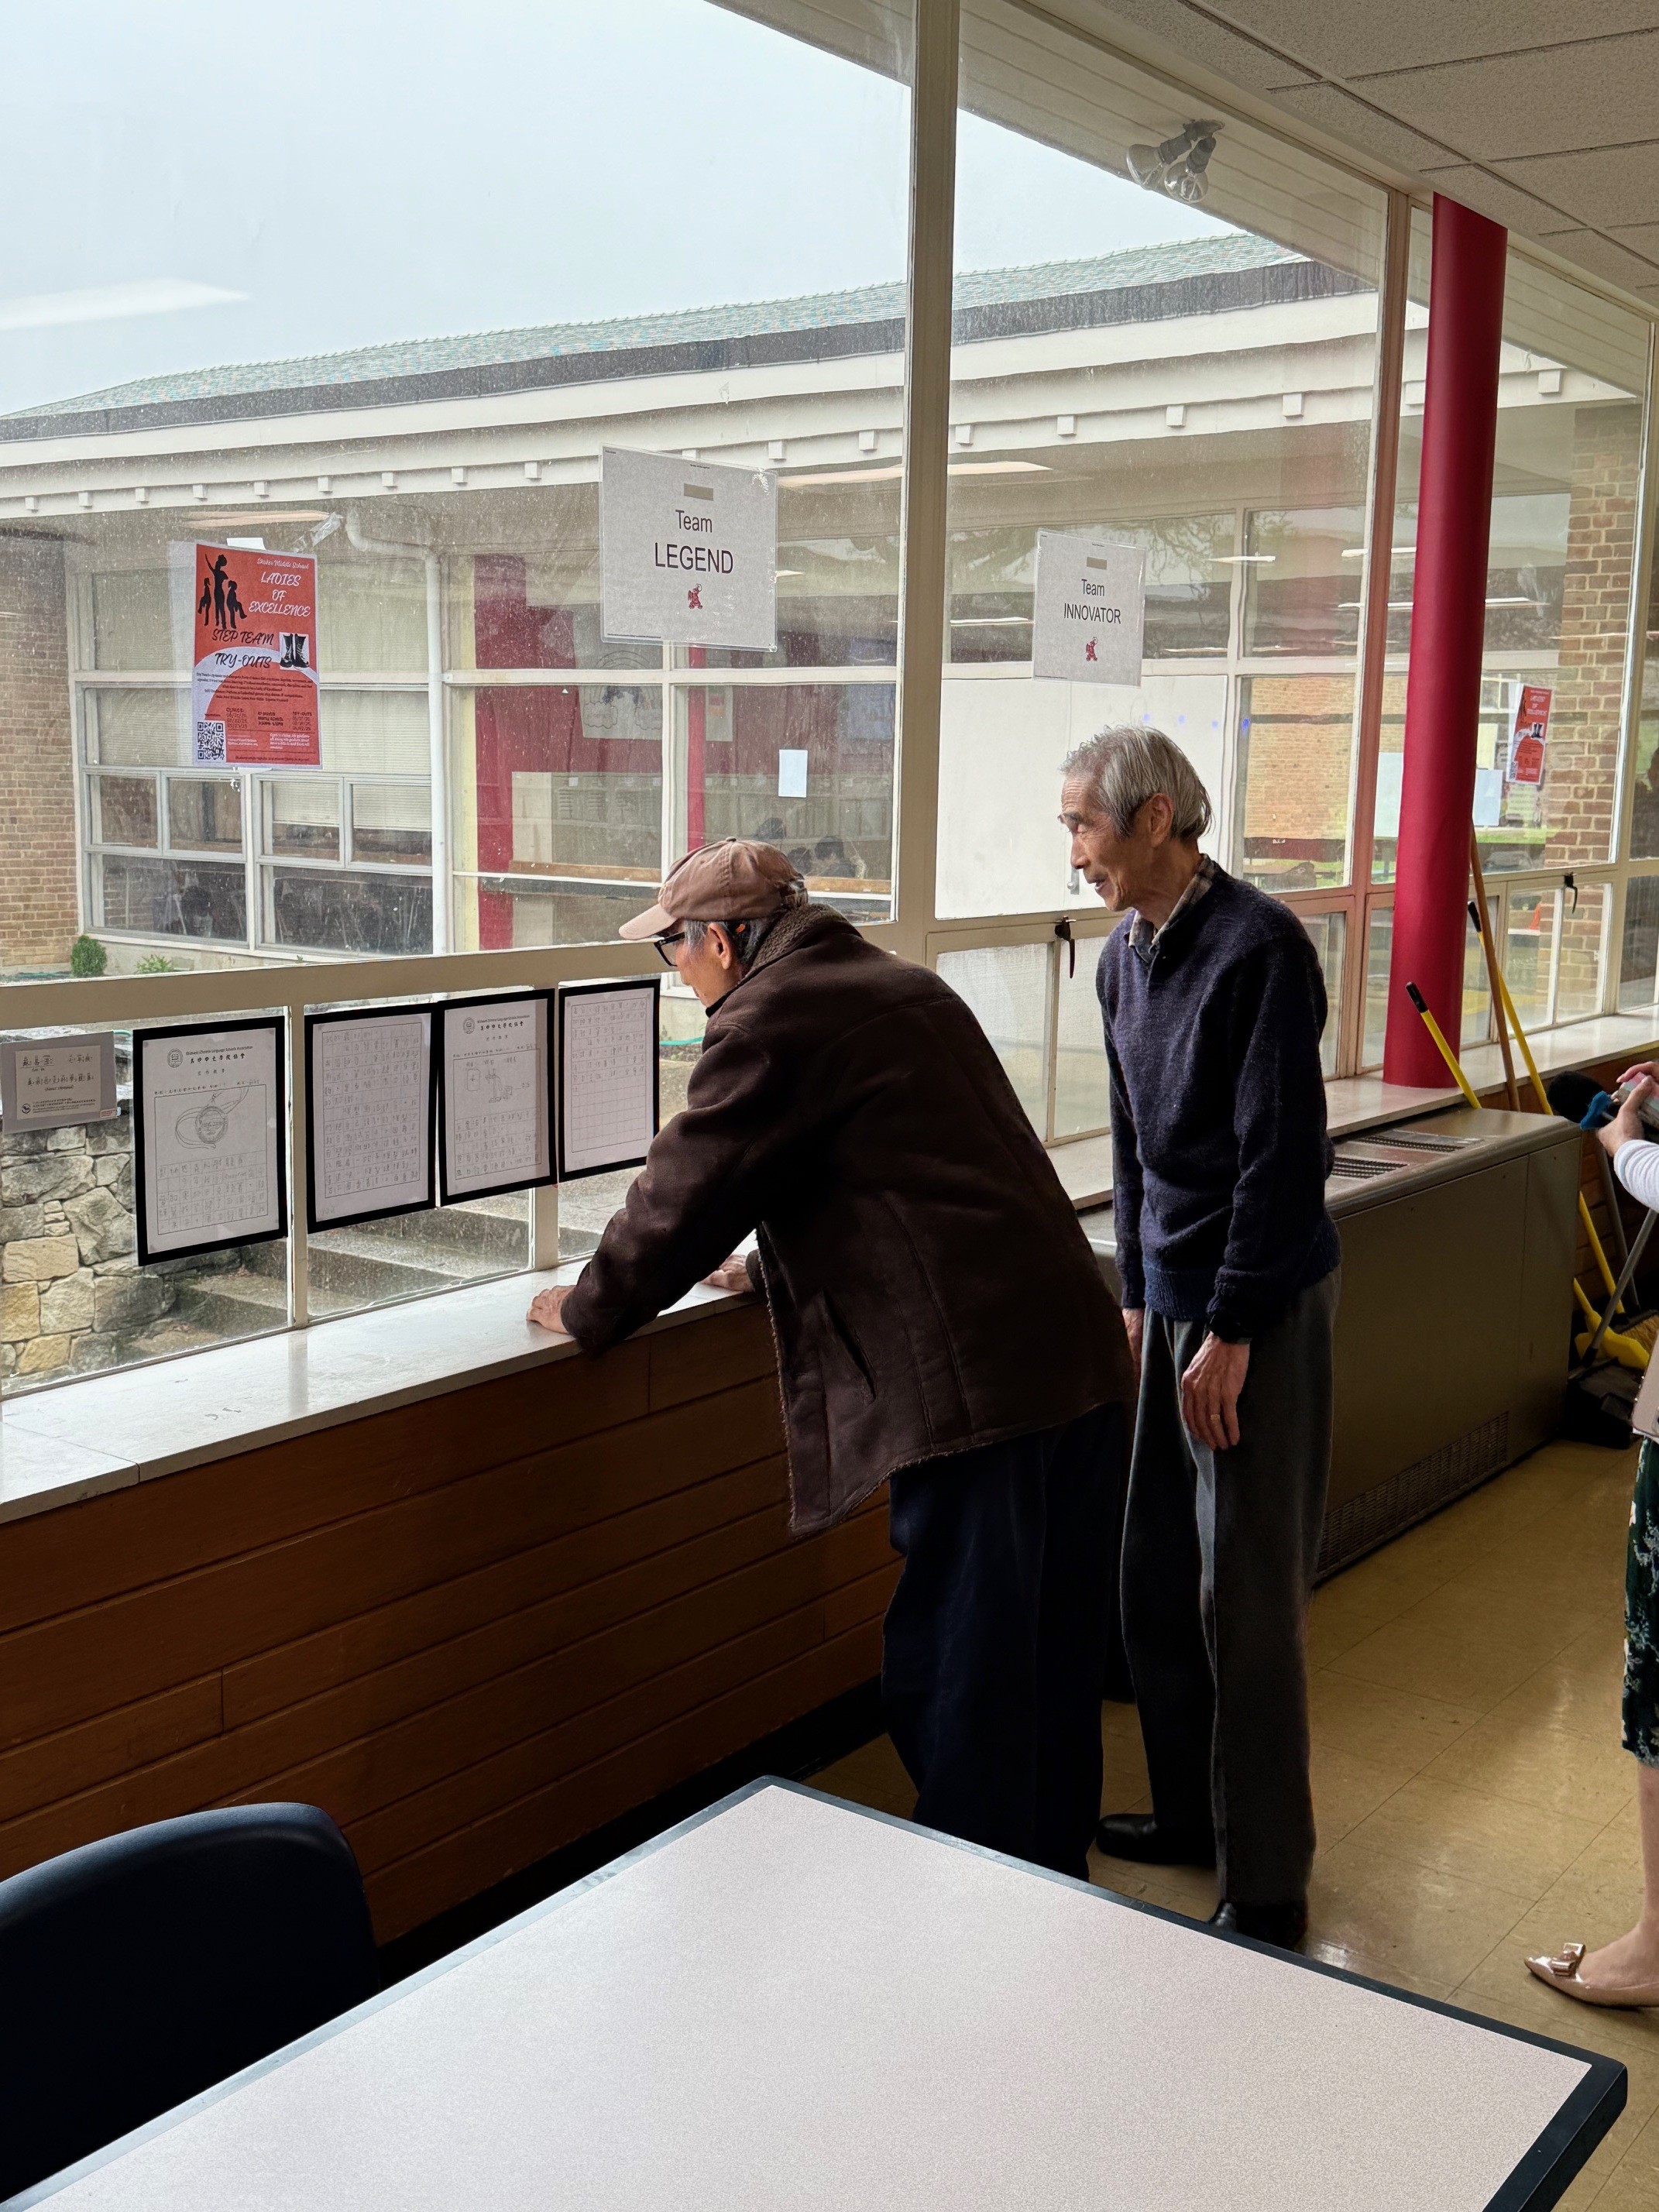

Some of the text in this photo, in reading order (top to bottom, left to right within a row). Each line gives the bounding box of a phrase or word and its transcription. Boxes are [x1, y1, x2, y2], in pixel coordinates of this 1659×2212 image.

[675, 509, 713, 533] Team
[654, 542, 733, 574] LEGEND
[260, 572, 301, 586] LADIES
[1081, 579, 1105, 596] Team
[272, 589, 287, 602] OF
[248, 600, 311, 617] EXCELLENCE
[1063, 603, 1121, 624] INNOVATOR
[211, 628, 274, 645] STEP TEAM
[215, 652, 273, 668] TRY-OUTS
